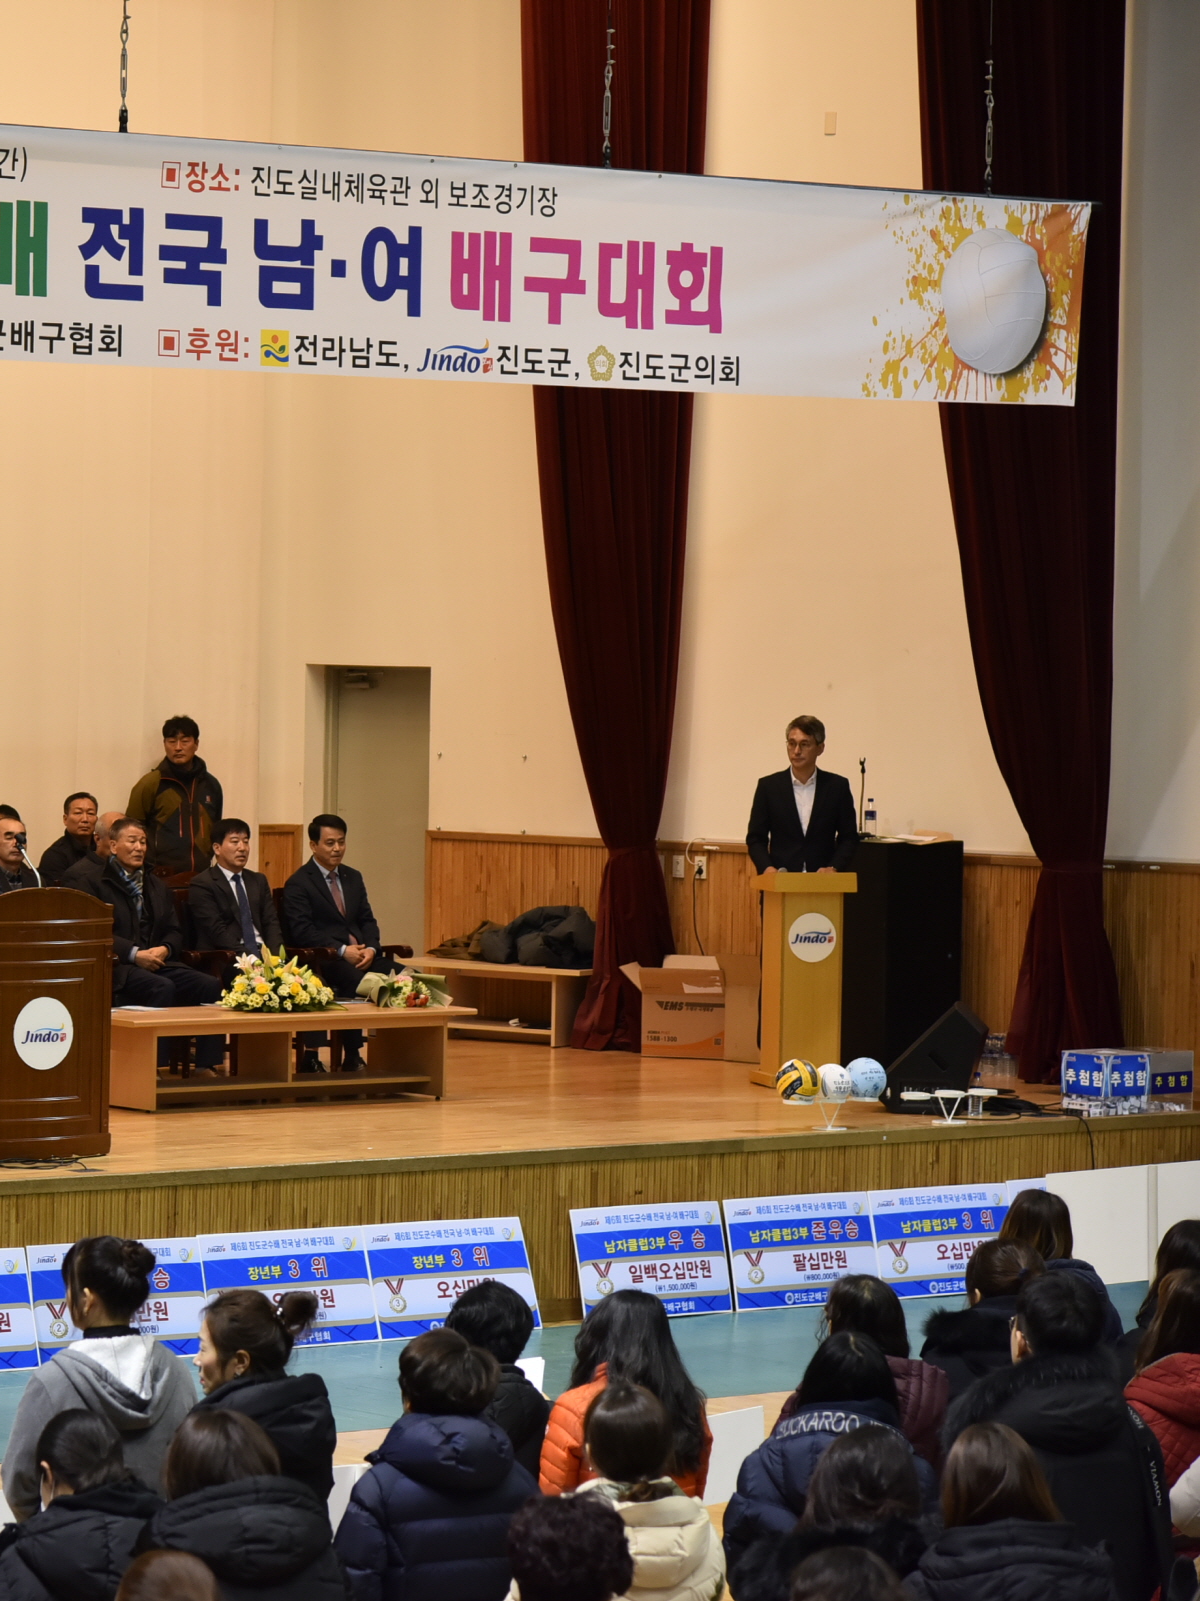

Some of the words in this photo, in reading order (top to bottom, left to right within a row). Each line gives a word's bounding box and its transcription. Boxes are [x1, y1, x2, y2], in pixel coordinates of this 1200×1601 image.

[185, 161, 240, 193] 장소:
[250, 165, 411, 207] 진도실내체육관
[419, 177, 438, 209] 외
[448, 181, 558, 217] 보조경기장
[78, 207, 227, 307] 전국
[450, 230, 723, 334] 배구대회
[185, 327, 249, 362] 후원:
[294, 334, 409, 372] 전라남도,
[417, 348, 481, 373] Jindo
[496, 345, 579, 380] 진도군,
[618, 351, 740, 386] 진도군의회
[791, 933, 827, 944] Jindo
[664, 1001, 684, 1011] EMS
[21, 1030, 59, 1044] Jindo
[877, 1200, 892, 1208] Jindo
[733, 1209, 749, 1217] Jindo
[580, 1219, 597, 1227] Jindo
[901, 1218, 958, 1234] 남자클럽3부
[371, 1235, 387, 1243] Jindo
[749, 1227, 809, 1243] 남자클럽3부
[206, 1245, 223, 1253] Jindo
[604, 1237, 666, 1253] 남자클럽3부
[37, 1255, 54, 1264] Jindo
[412, 1255, 446, 1269] 장년부
[793, 1250, 848, 1272] 팔십만원
[248, 1266, 282, 1281] 장년부
[628, 1260, 712, 1284] 일백오십만원
[794, 1292, 828, 1303] 진도군배구
